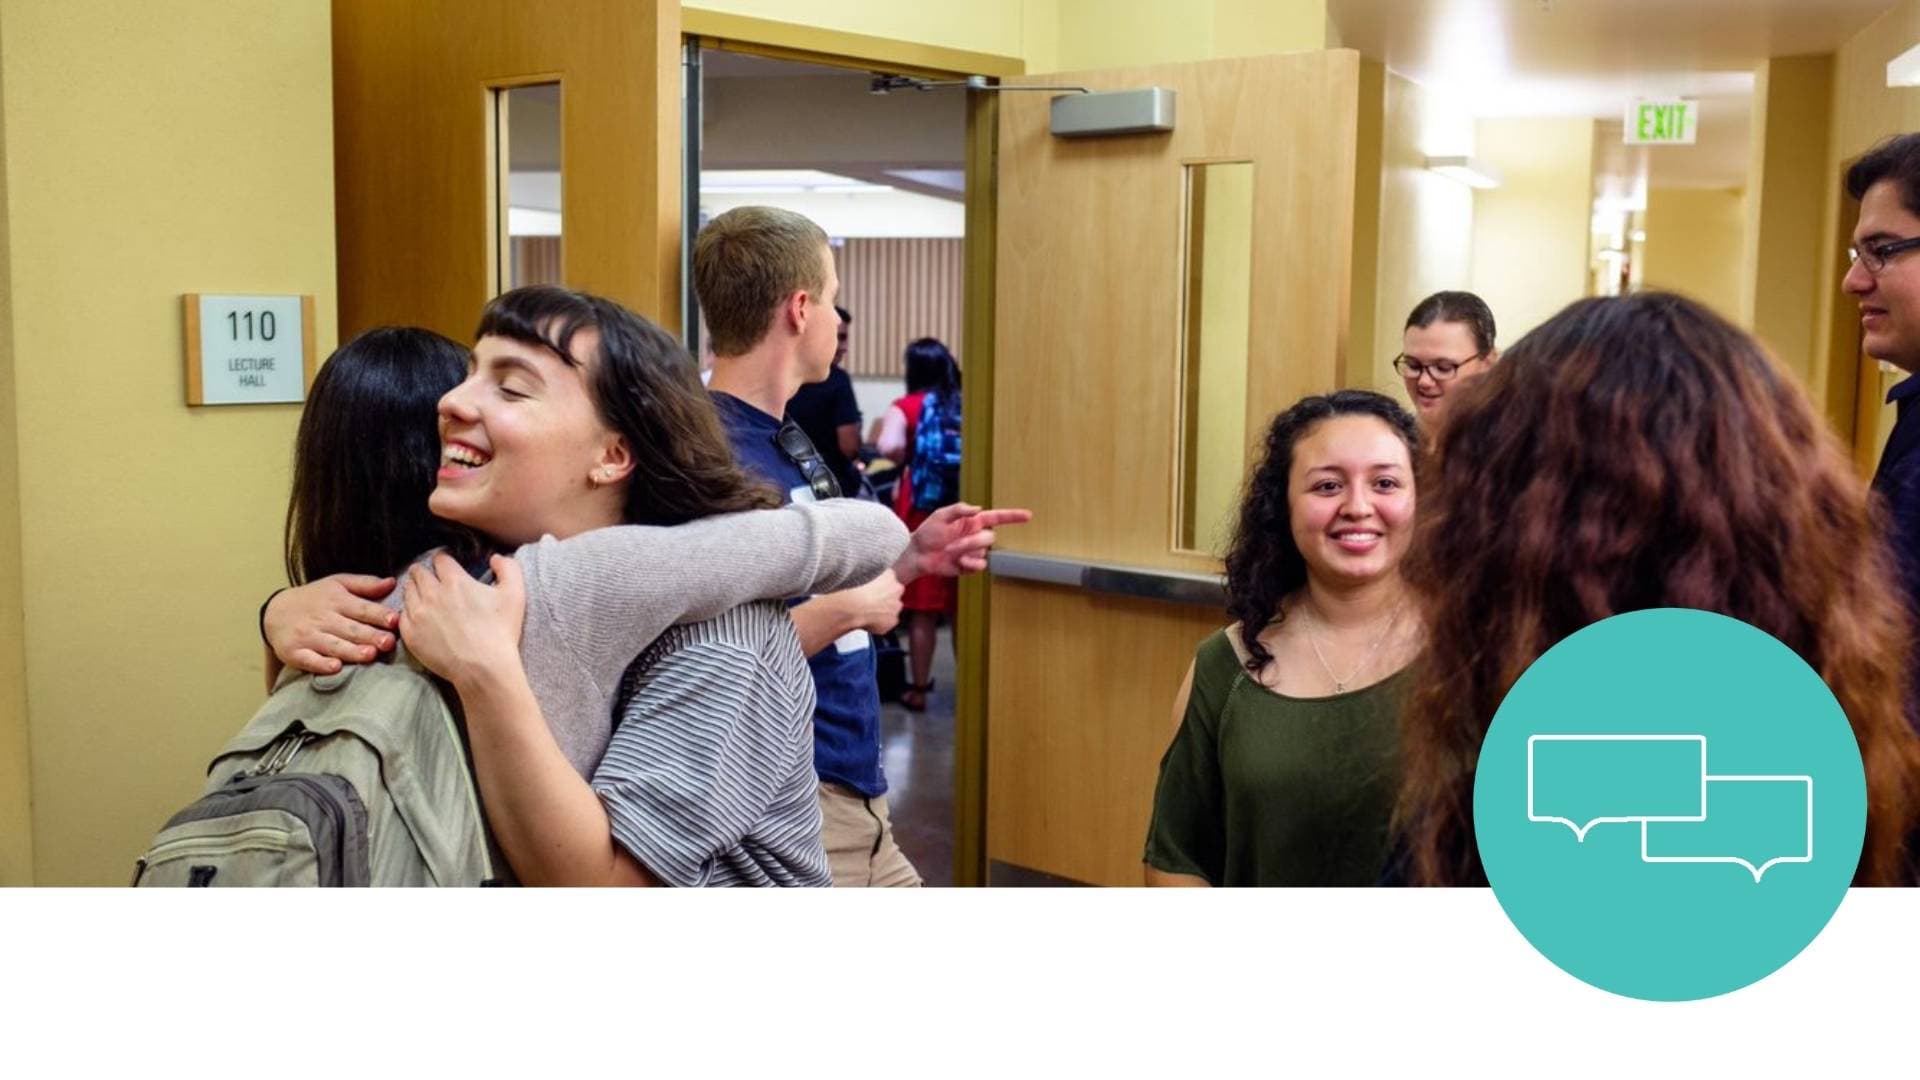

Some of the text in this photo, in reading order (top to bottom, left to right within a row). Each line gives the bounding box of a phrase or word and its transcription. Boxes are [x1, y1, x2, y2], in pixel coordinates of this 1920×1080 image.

[1637, 103, 1686, 140] EXIT
[227, 310, 276, 342] 110
[228, 358, 276, 372] LECTURE
[238, 374, 267, 388] HALL
